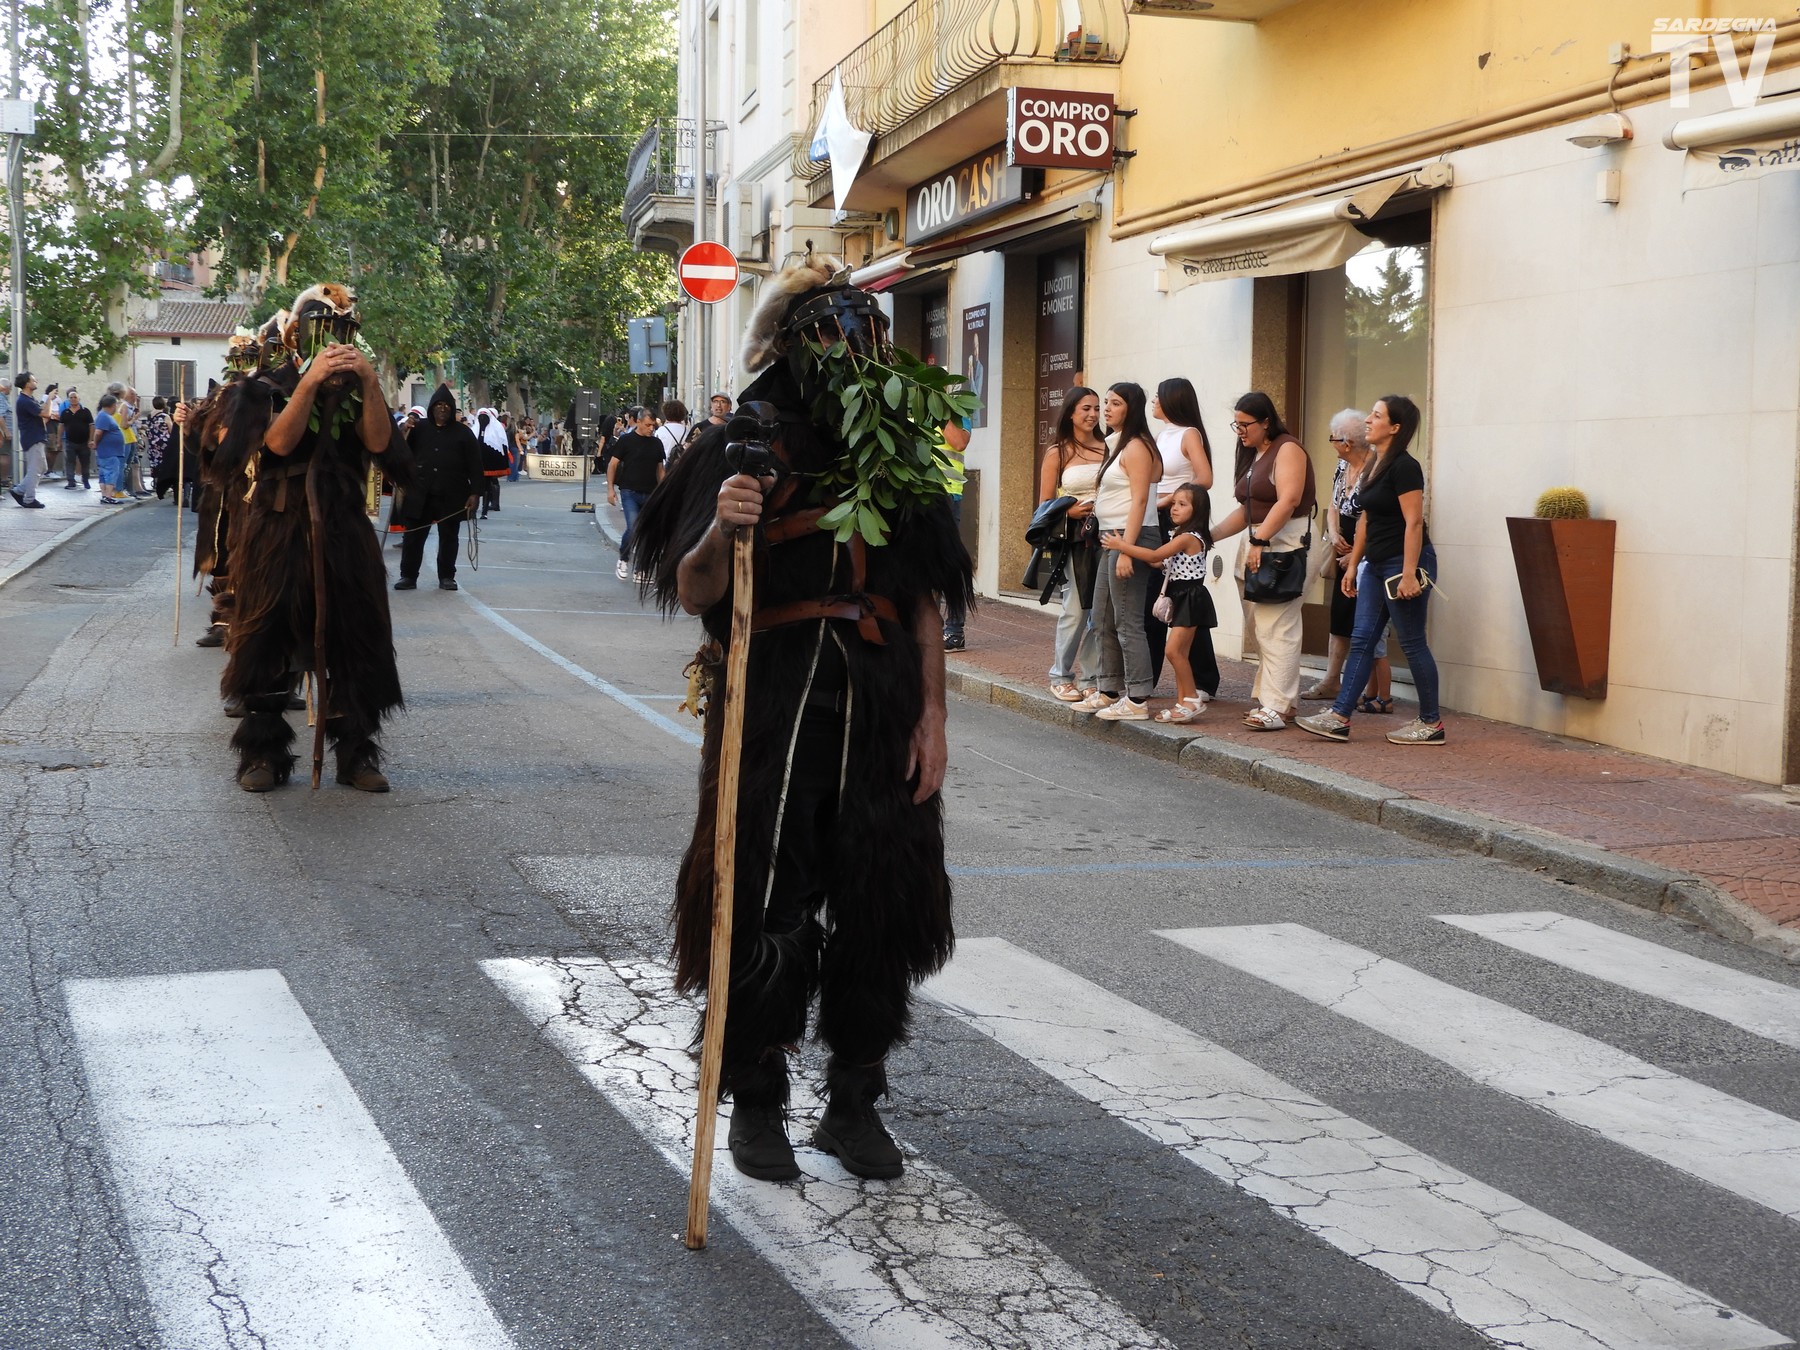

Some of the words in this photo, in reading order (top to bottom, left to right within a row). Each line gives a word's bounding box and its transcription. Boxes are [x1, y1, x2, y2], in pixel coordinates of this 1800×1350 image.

[1020, 99, 1110, 122] COMPRO
[1018, 119, 1110, 157] ORO
[1044, 274, 1073, 296] LINGOTTI
[1042, 301, 1047, 316] E
[1047, 295, 1073, 315] MONETE
[1049, 352, 1069, 363] QUOTAZIONI
[1053, 362, 1064, 370] TEMPO
[1063, 360, 1073, 369] REALE
[541, 468, 575, 477] SORGONO
